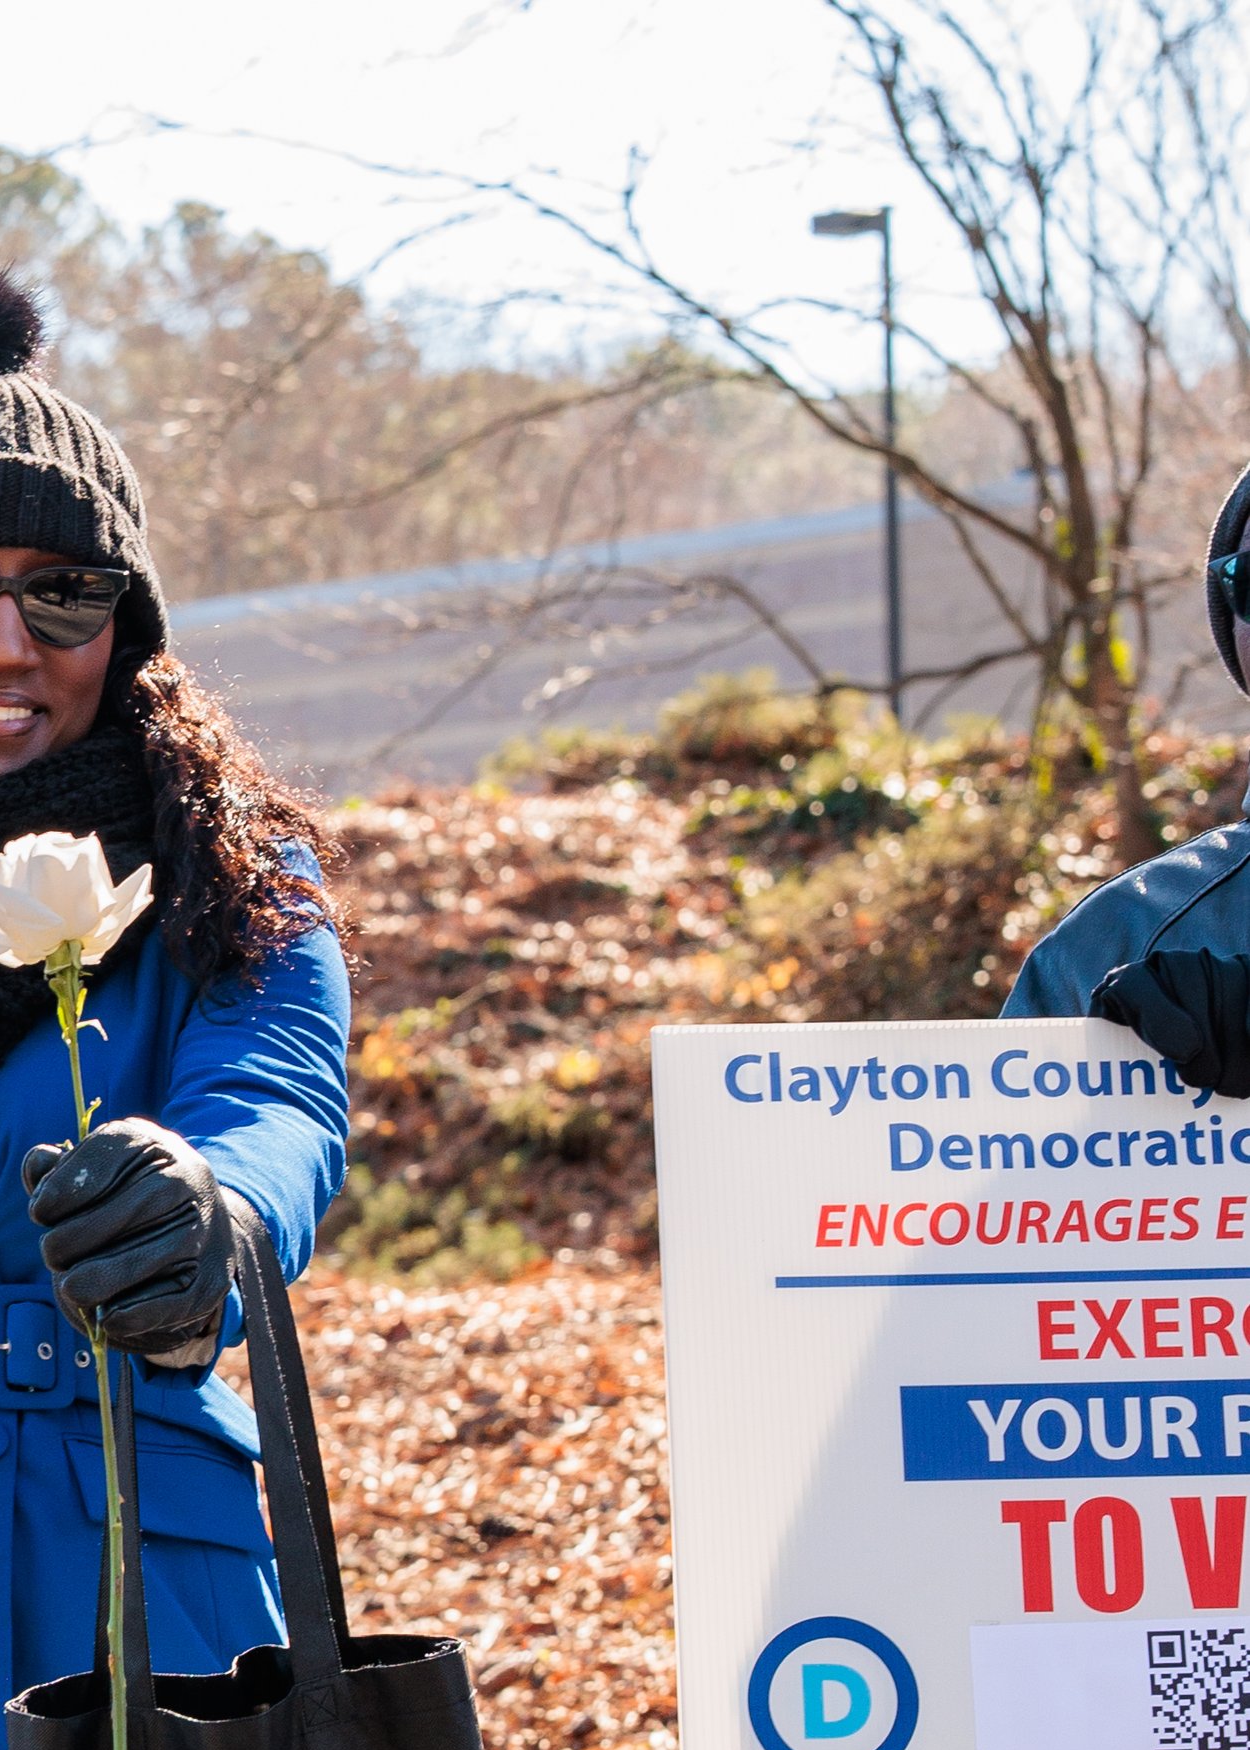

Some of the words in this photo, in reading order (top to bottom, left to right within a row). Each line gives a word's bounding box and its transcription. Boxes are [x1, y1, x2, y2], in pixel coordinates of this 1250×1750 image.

[724, 1052, 970, 1116] Clayton
[815, 1196, 1199, 1248] ENCOURAGES
[1037, 1296, 1250, 1360] EXER
[968, 1395, 1202, 1462] YOUR
[1001, 1496, 1145, 1614] TO
[801, 1663, 873, 1741] D
